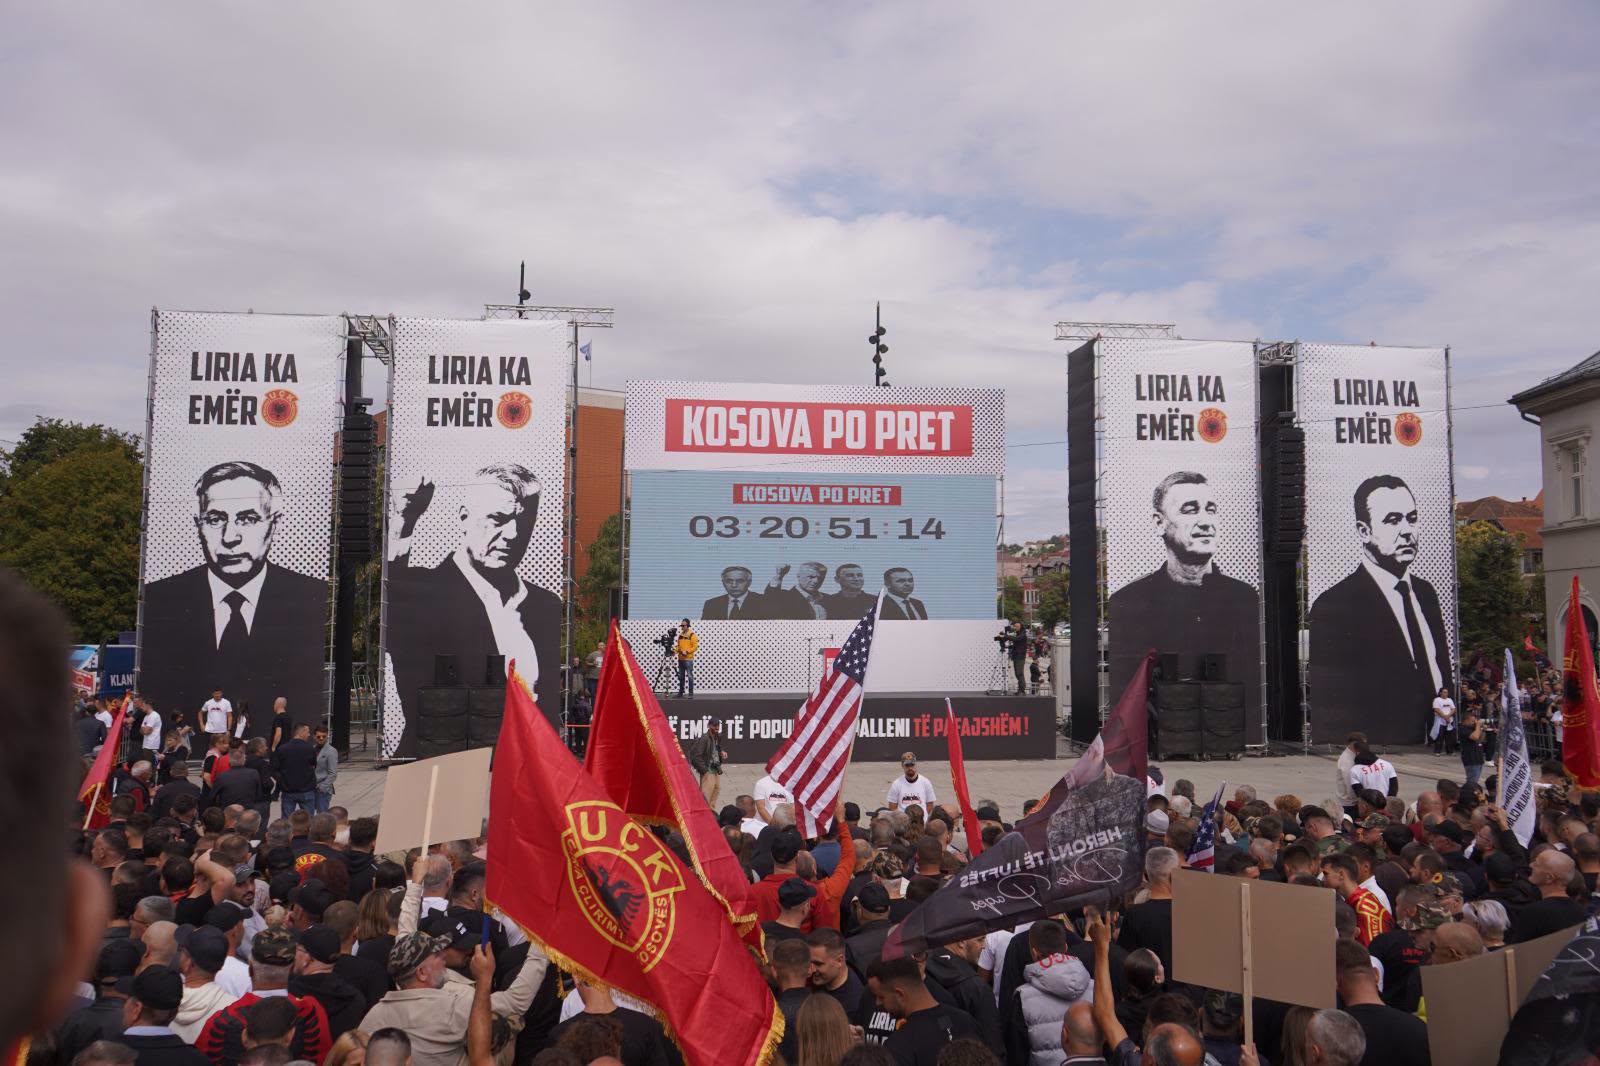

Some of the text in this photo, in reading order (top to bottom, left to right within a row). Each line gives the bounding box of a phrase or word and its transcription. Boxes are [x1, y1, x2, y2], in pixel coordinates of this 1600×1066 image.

[191, 351, 298, 383] LIRIA KA
[428, 355, 532, 385] LIRIA KA
[1135, 374, 1226, 402] LIRIA KA
[1333, 378, 1420, 407] LIRIA KA
[188, 388, 258, 425] EMËR
[426, 391, 494, 427] EMËR
[683, 405, 955, 451] KOSOVA PO PRET
[1136, 407, 1195, 441] EMËR
[1335, 411, 1392, 444] EMËR
[742, 486, 892, 504] KOSOVA PO PRET
[725, 715, 744, 739] TË
[749, 719, 795, 739] POPU
[913, 713, 930, 737] TË
[580, 810, 673, 885] UÇK
